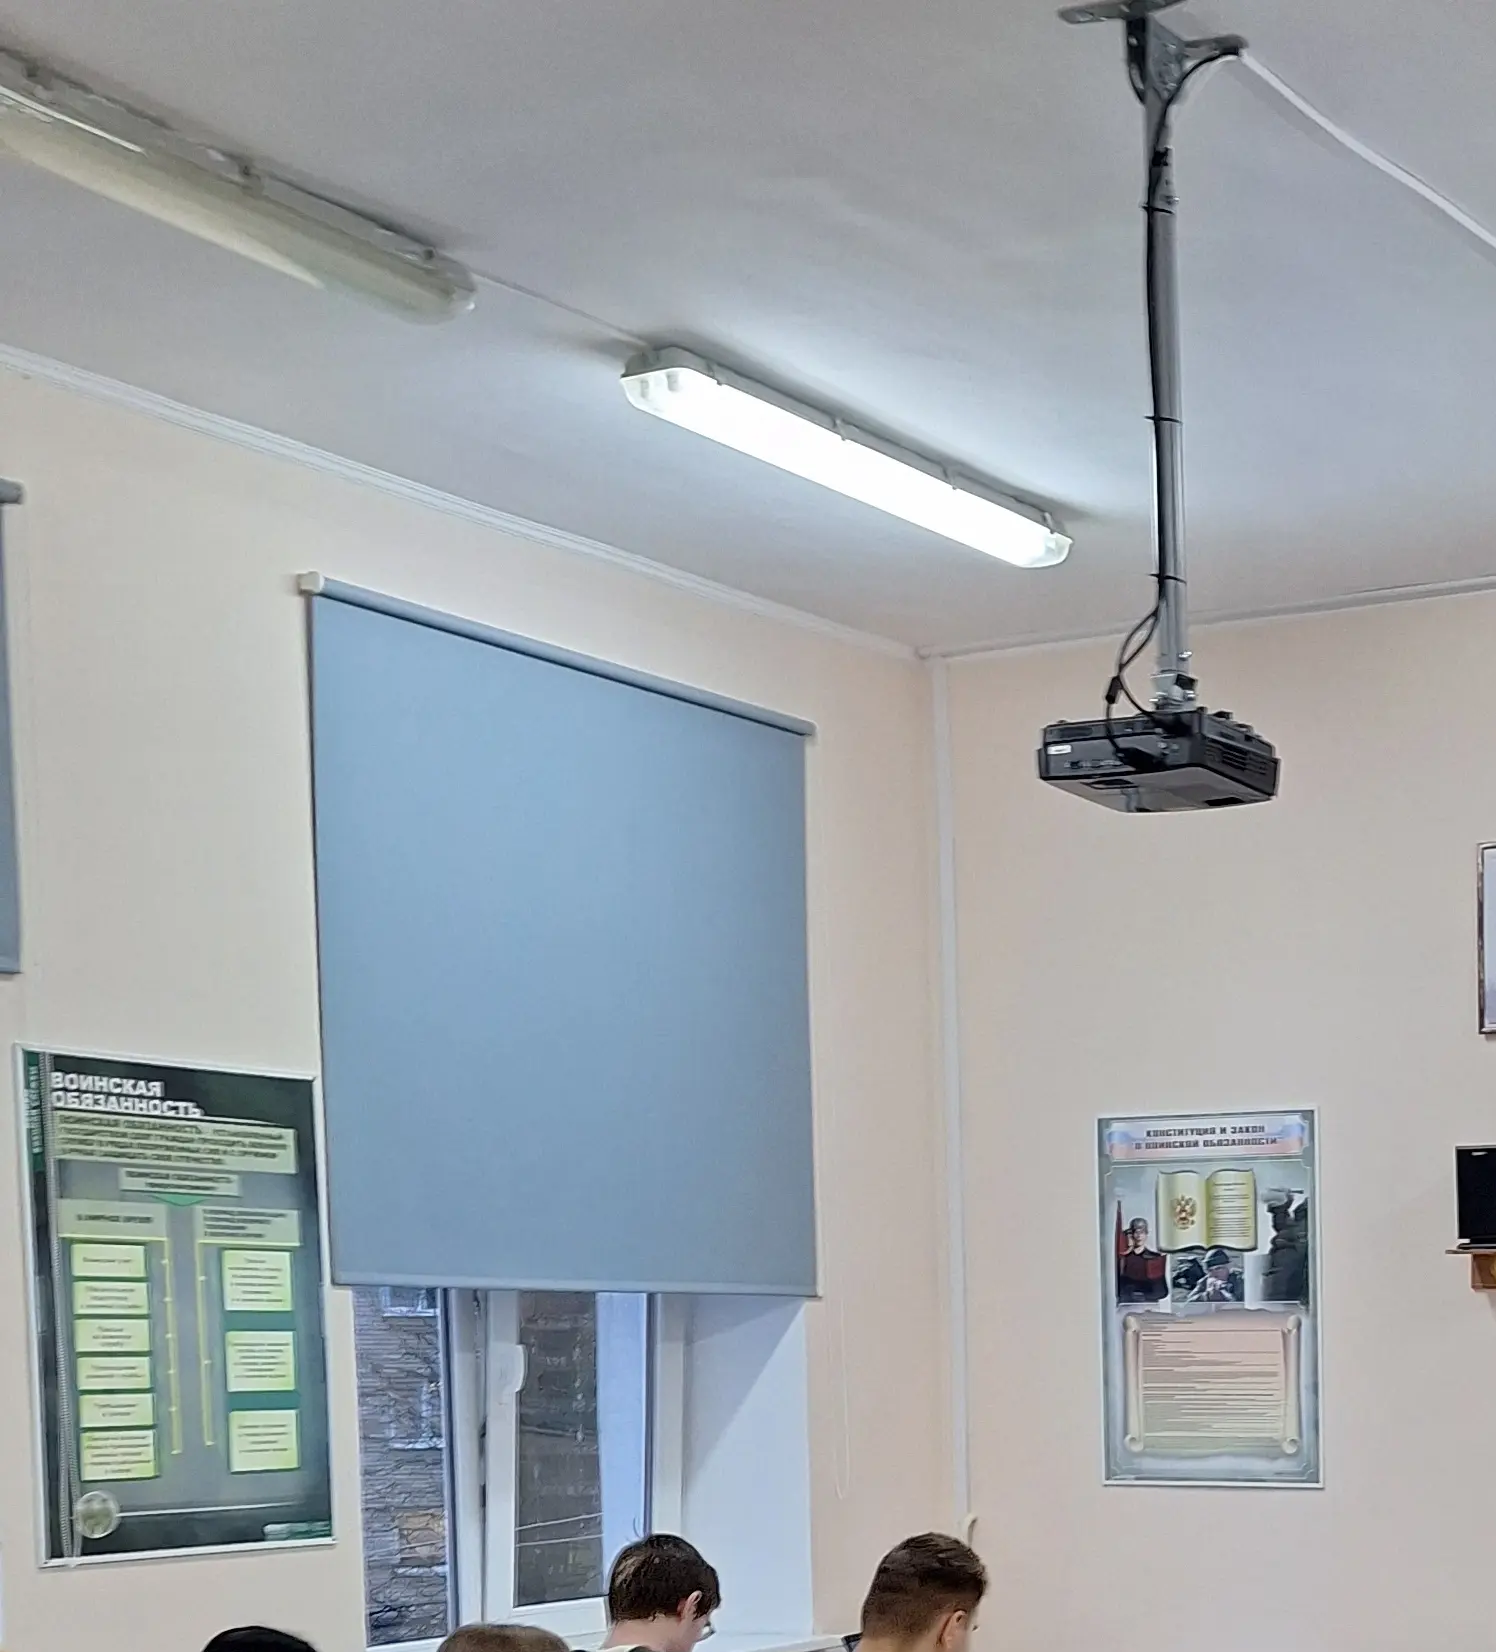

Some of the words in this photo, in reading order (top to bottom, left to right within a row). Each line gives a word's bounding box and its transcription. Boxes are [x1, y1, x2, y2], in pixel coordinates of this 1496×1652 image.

[51, 1071, 165, 1097] ВОИНСКАЯ
[52, 1091, 205, 1117] ОБЯЗАННОСТЬ
[1146, 1127, 1216, 1138] КОНСТИТУЦИЯ
[1220, 1126, 1227, 1134] И
[1230, 1125, 1265, 1134] ЗАКОН
[1145, 1140, 1199, 1150] ВОИНСКОЙ
[1202, 1137, 1277, 1148] ОБЯЗАННОСТИ
